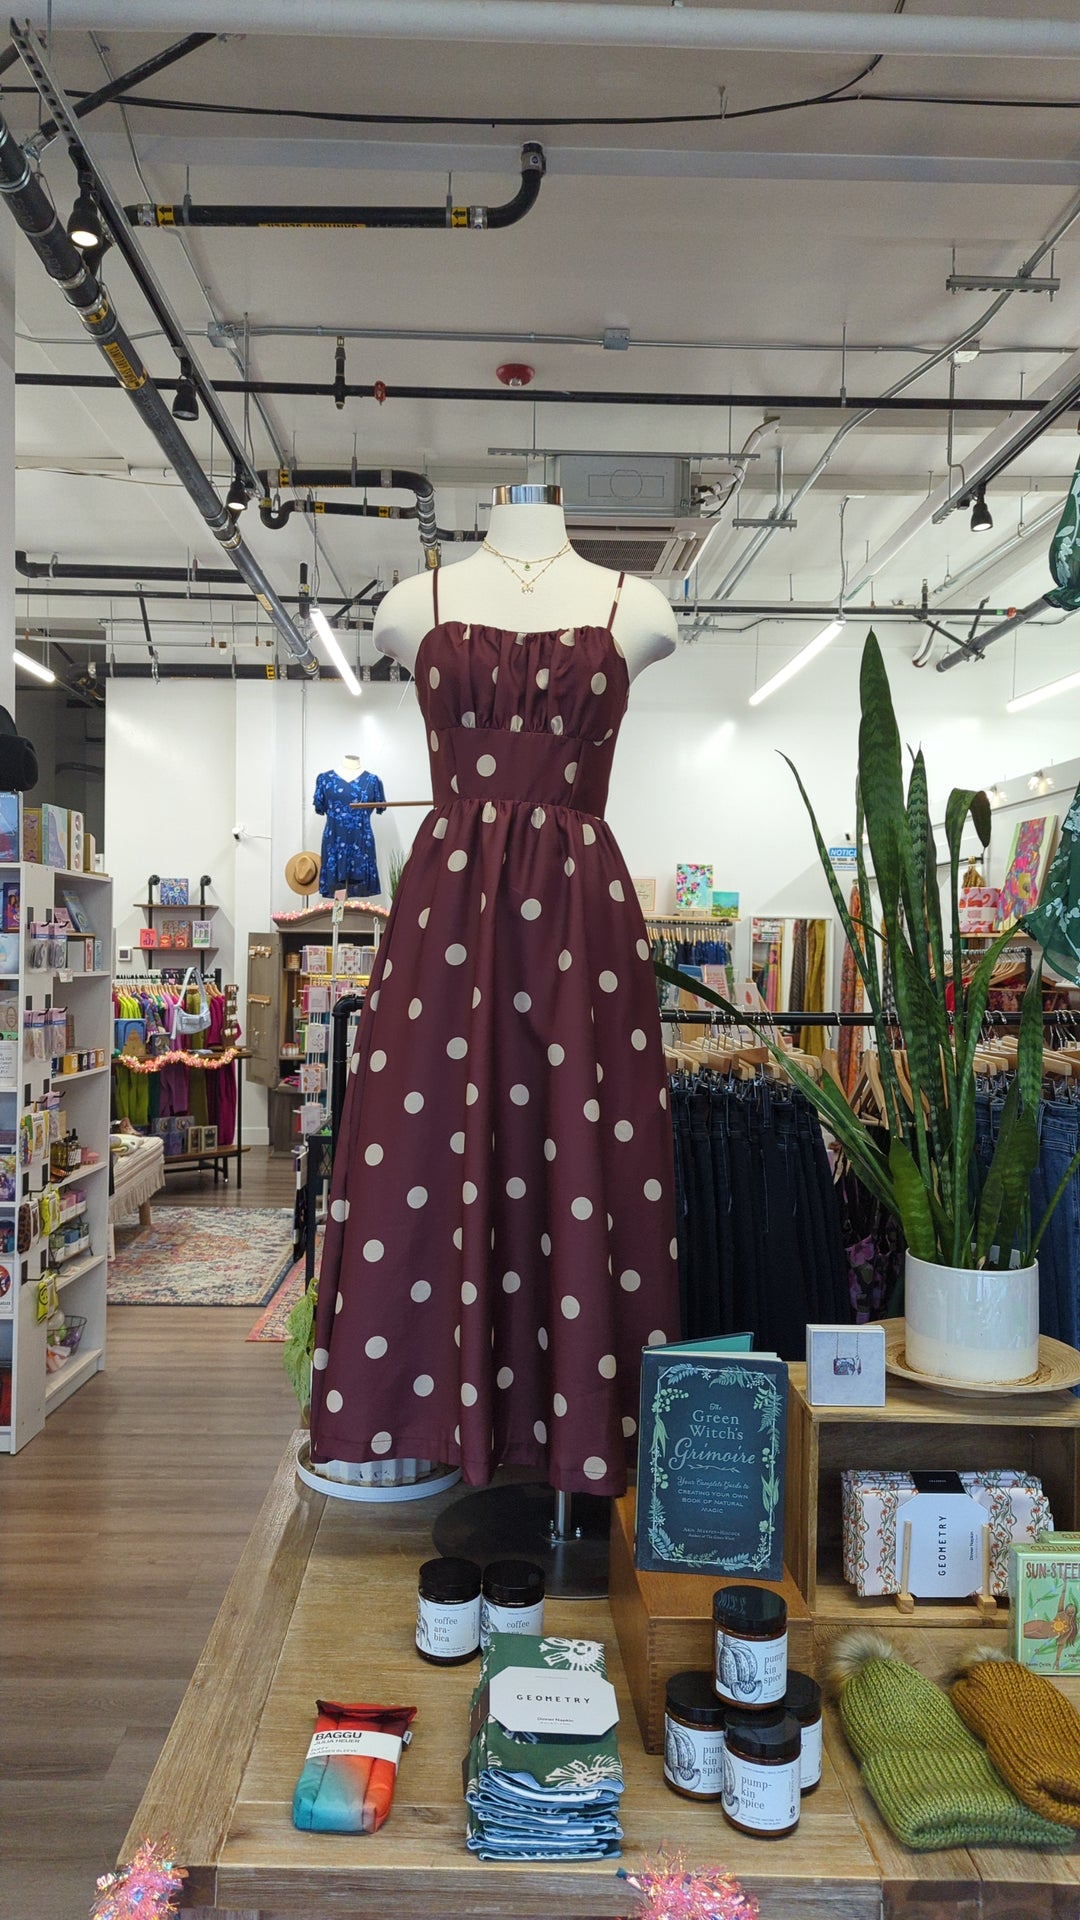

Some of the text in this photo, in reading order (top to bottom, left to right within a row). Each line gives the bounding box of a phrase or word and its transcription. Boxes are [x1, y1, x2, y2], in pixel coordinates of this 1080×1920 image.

[709, 1403, 722, 1411] The
[692, 1410, 740, 1425] Green
[689, 1424, 744, 1441] Witch's
[668, 1437, 756, 1471] Grimoire
[677, 1476, 695, 1487] Your
[696, 1478, 722, 1489] Complete
[724, 1480, 742, 1490] Guide
[677, 1488, 710, 1497] CREATING
[937, 1515, 948, 1577] GEOMETRY
[1026, 1562, 1080, 1579] SUN-STEE
[434, 1616, 458, 1625] coffee
[506, 1620, 530, 1629] coffee
[434, 1626, 451, 1634] ara-
[433, 1633, 450, 1643] bica
[764, 1665, 777, 1675] kin
[763, 1673, 782, 1686] spice
[516, 1694, 591, 1704] GEOMETRY
[315, 1731, 362, 1740] BAGGU
[703, 1746, 723, 1760] pum
[702, 1756, 717, 1766] kin
[741, 1776, 772, 1791] pump-
[741, 1788, 756, 1799] kin
[740, 1797, 765, 1810] spice
